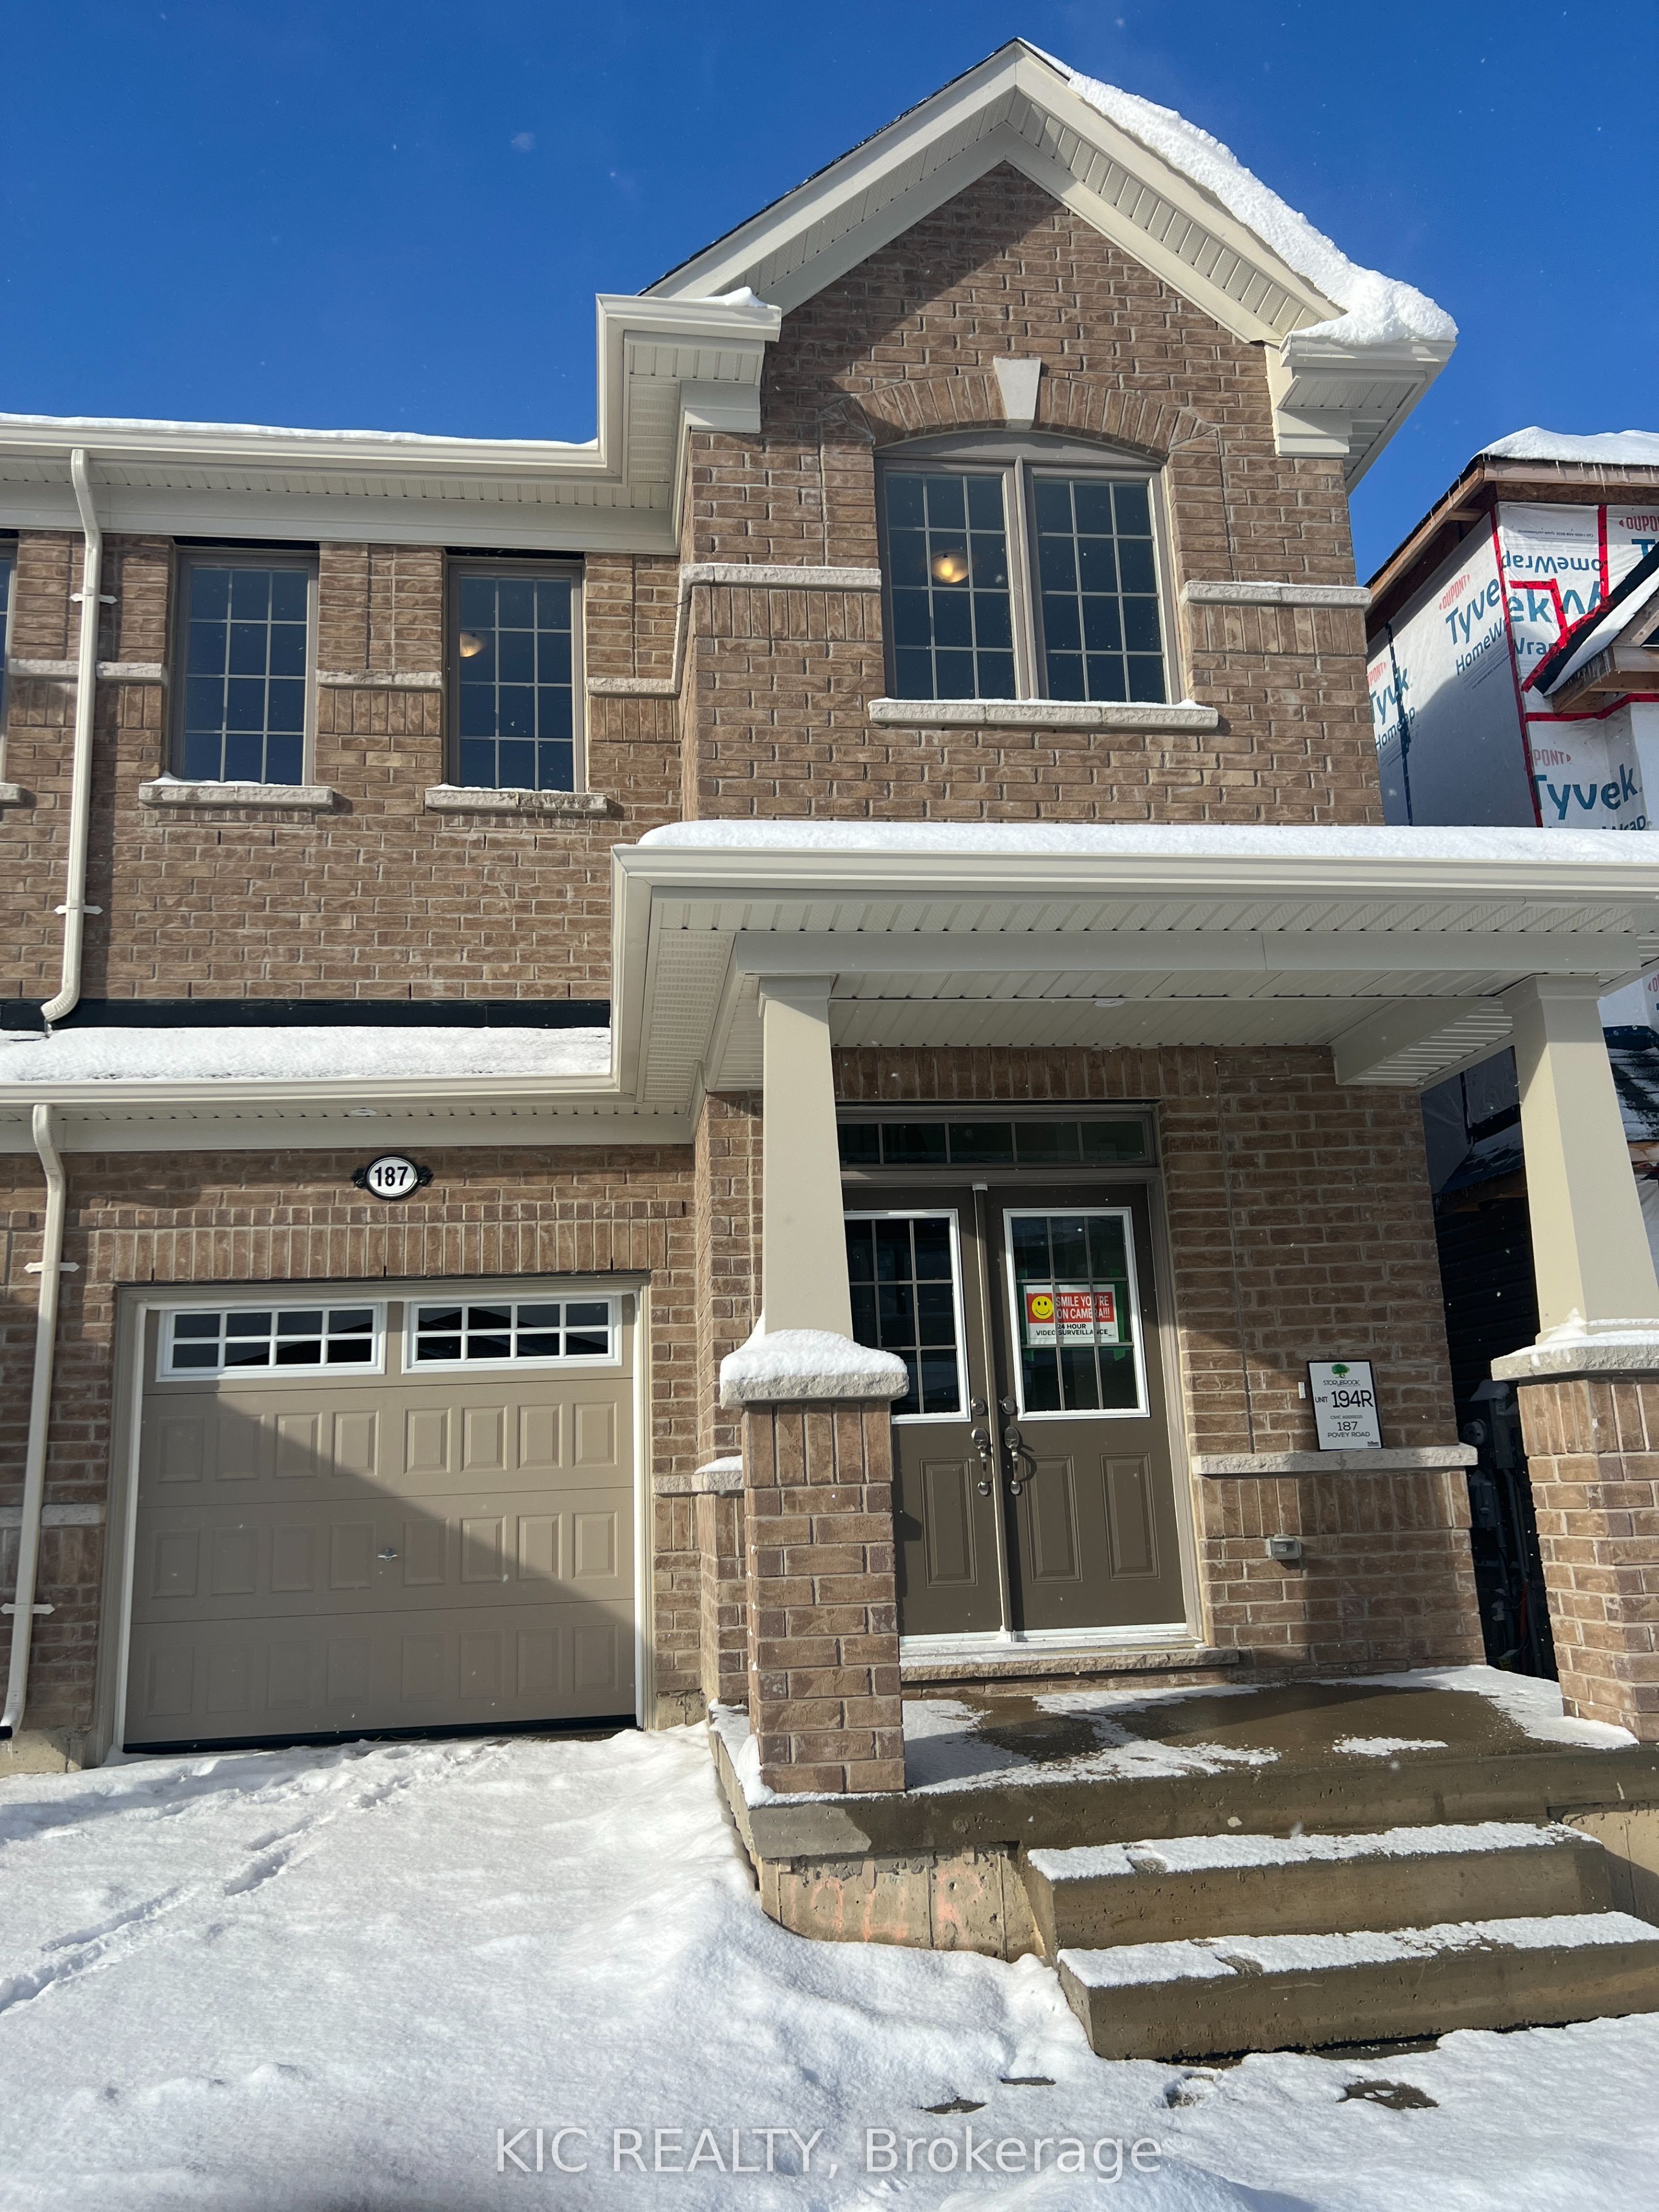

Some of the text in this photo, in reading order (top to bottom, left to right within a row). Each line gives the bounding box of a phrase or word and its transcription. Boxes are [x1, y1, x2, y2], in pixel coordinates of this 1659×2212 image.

[1626, 515, 1659, 532] DUPO
[1442, 575, 1467, 609] DUPONT
[1534, 763, 1638, 820] Tyvek
[374, 1166, 408, 1187] 187
[1056, 1296, 1079, 1307] SMILE
[1056, 1309, 1069, 1319] ON
[1331, 1389, 1374, 1408] 194R
[1337, 1421, 1358, 1431] 187
